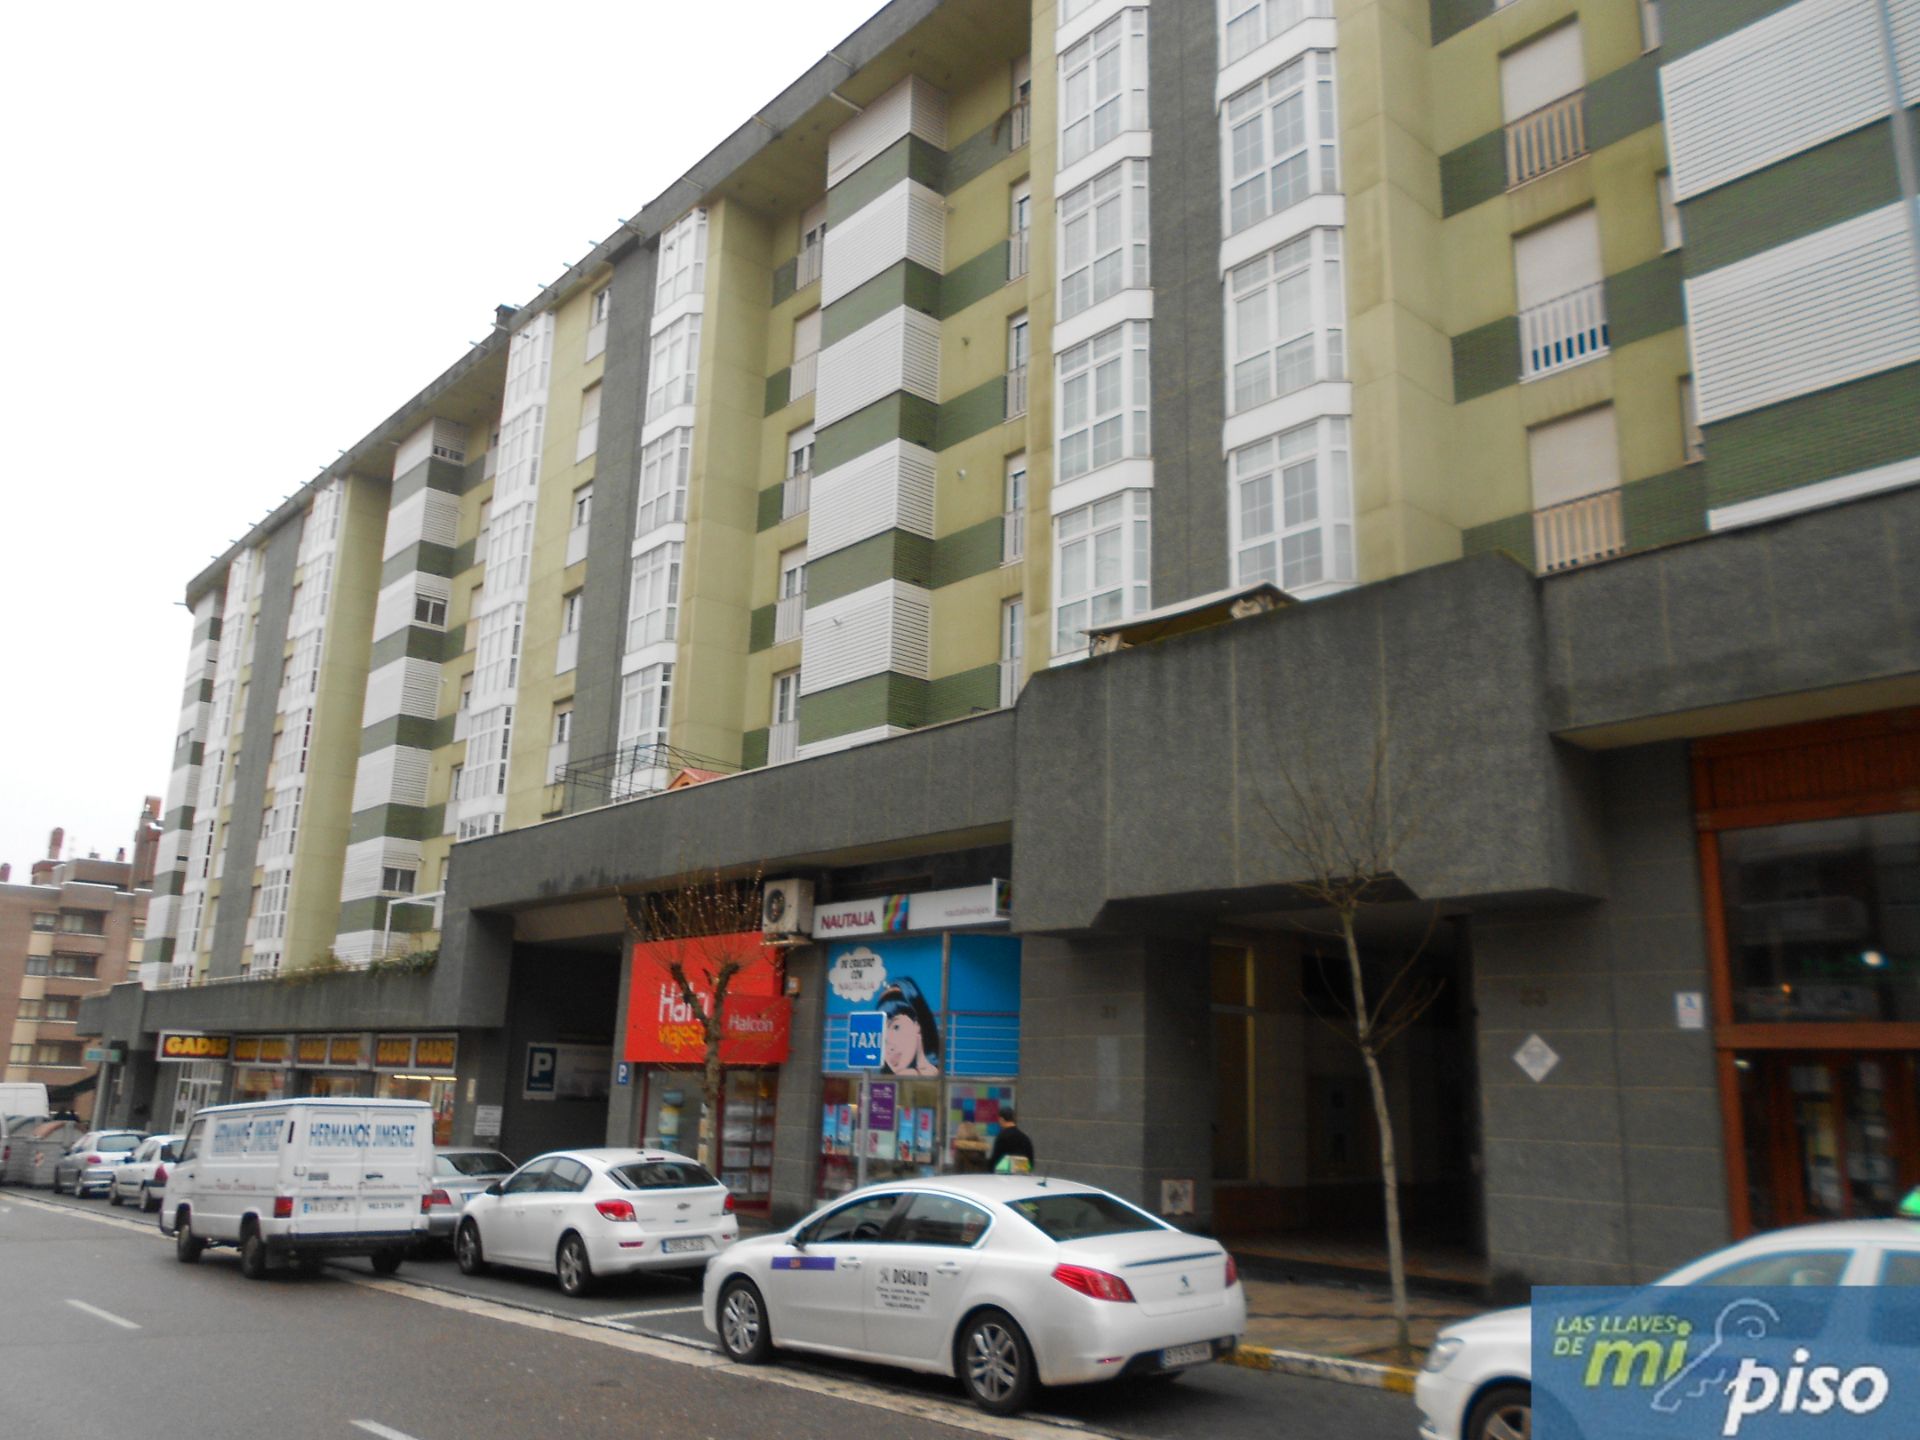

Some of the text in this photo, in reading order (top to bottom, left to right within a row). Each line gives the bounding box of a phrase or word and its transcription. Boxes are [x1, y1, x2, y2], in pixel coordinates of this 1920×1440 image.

[820, 911, 877, 930] NAUTALIA
[164, 1036, 229, 1056] GADIS
[850, 1032, 881, 1049] TAXI
[310, 1123, 415, 1147] HERMANOS JIMENEZ
[893, 1268, 928, 1287] DISAUTO
